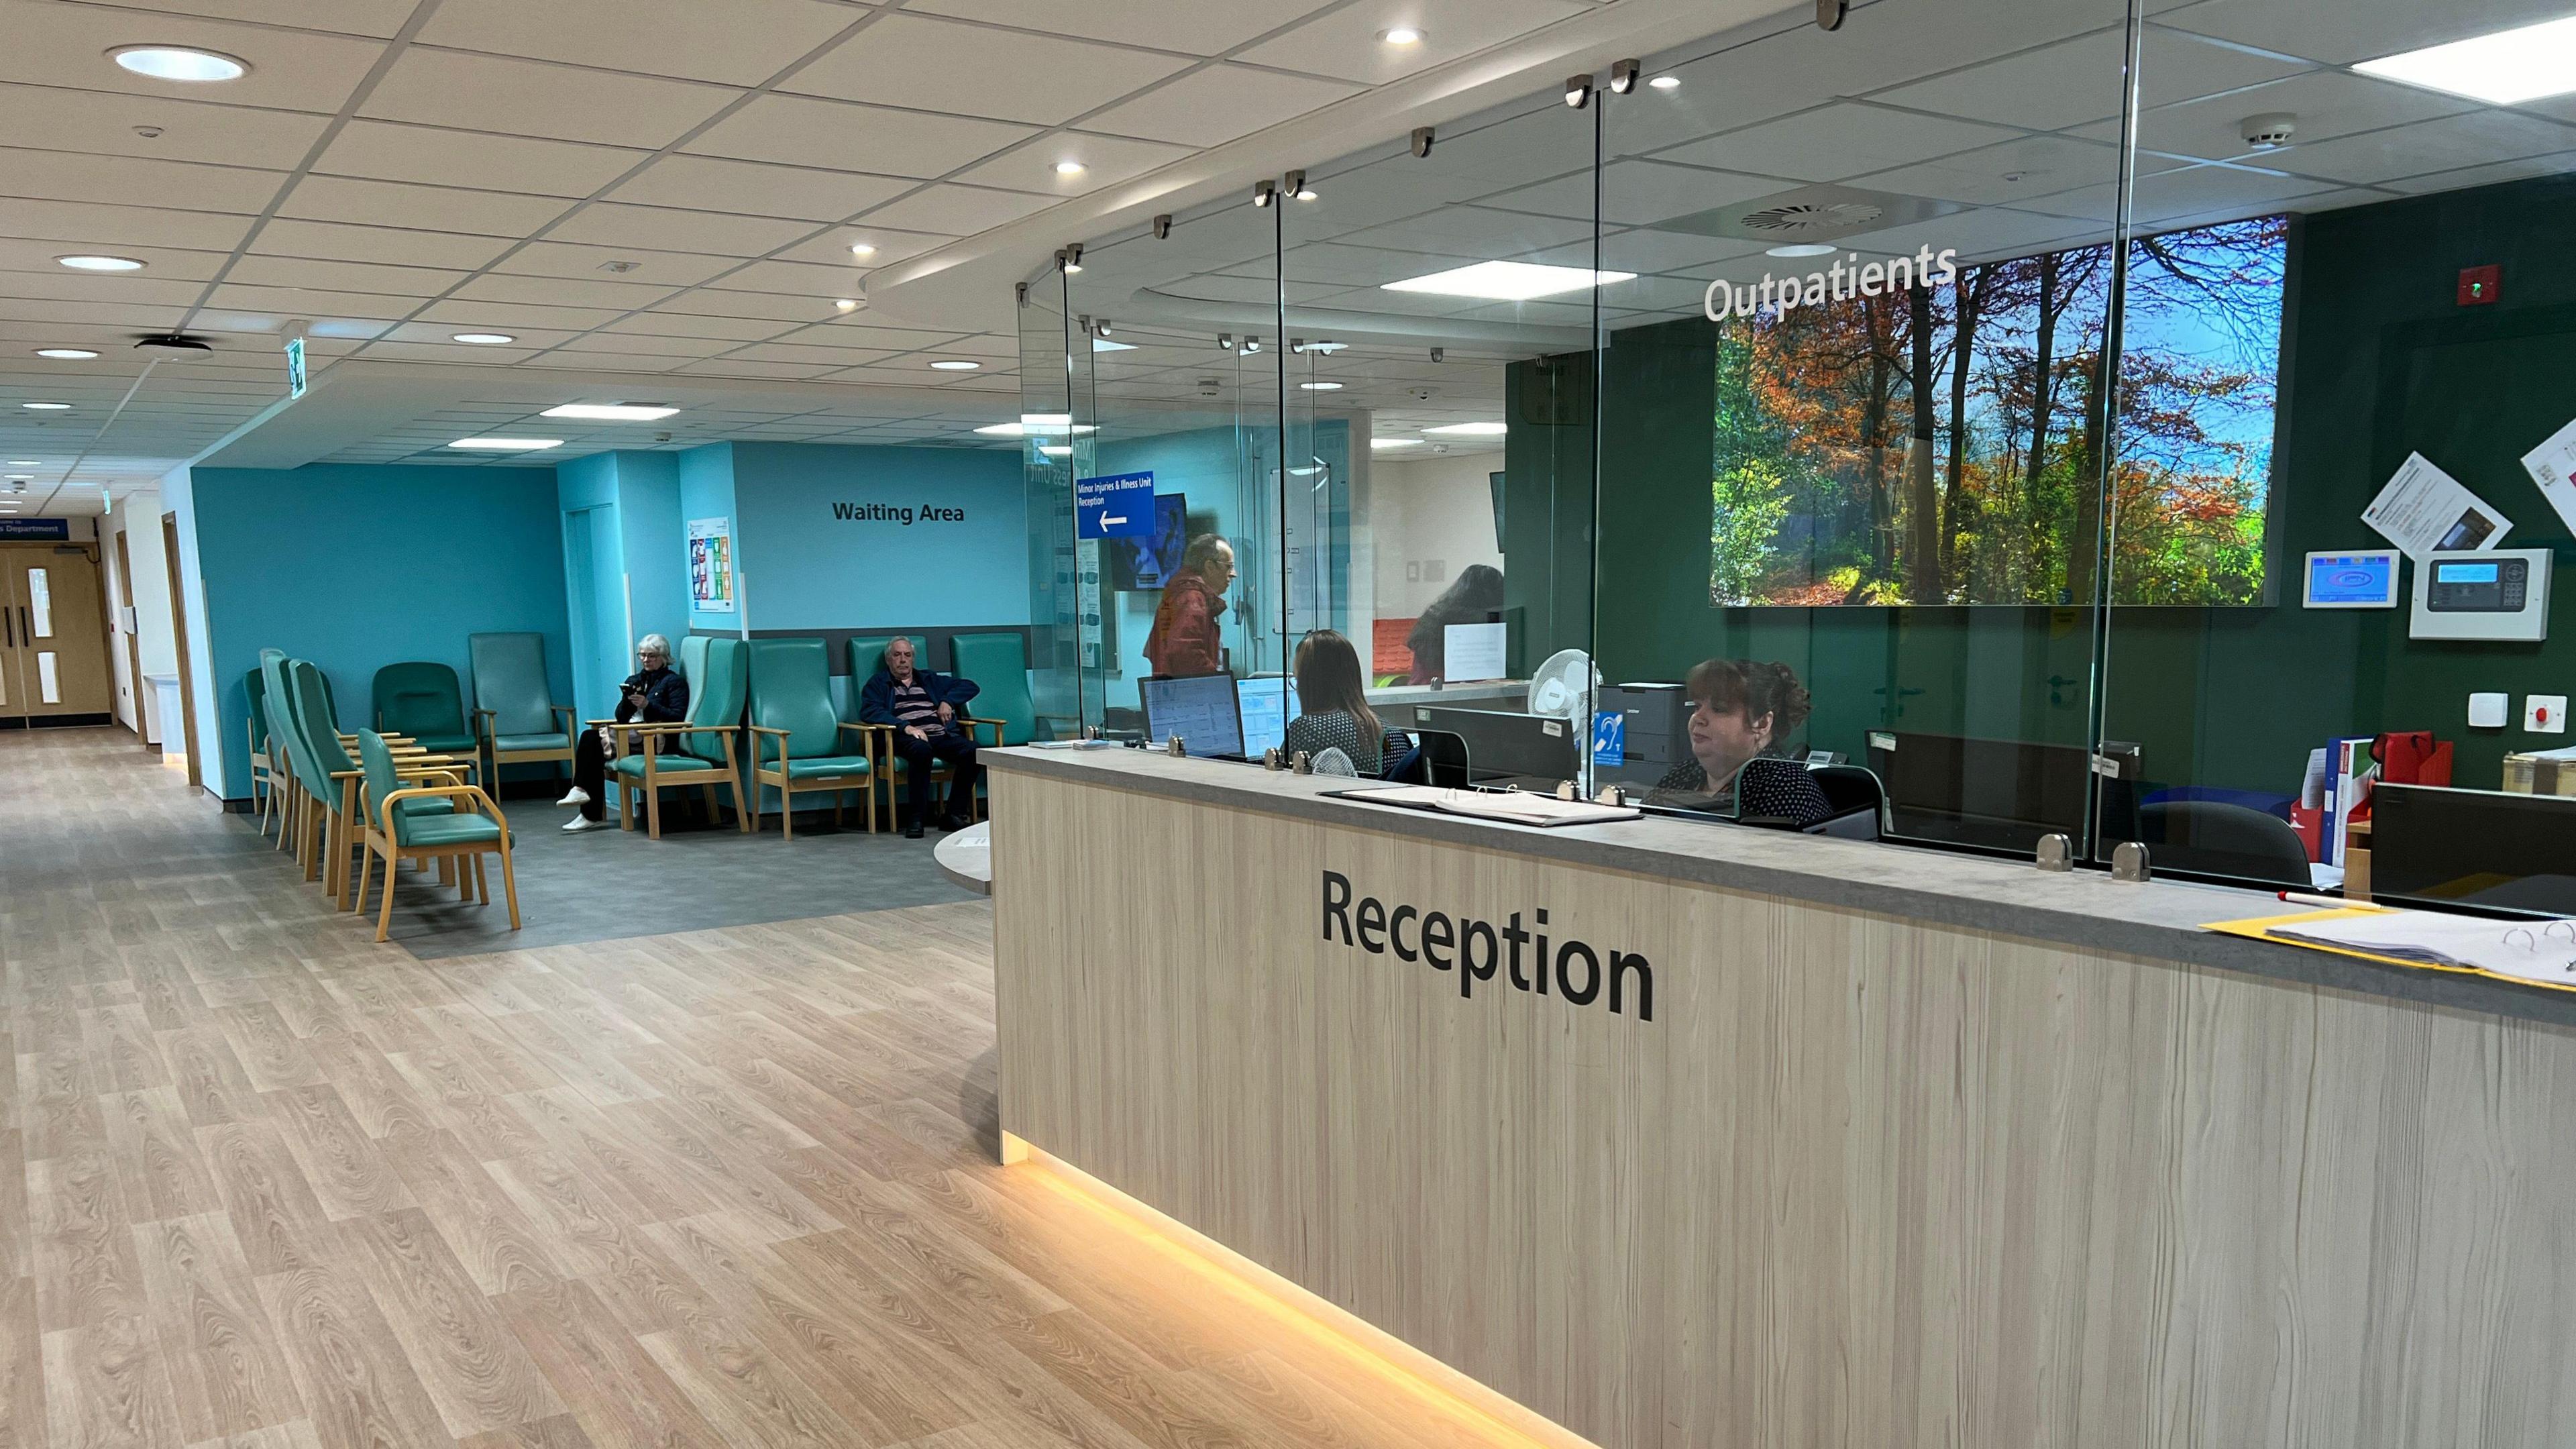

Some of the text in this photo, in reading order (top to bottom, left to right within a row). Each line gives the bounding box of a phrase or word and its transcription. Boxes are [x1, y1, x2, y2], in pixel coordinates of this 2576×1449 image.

[1705, 243, 1956, 323] Outpatients
[1078, 476, 1152, 494] Minor Injuries & Illness Unit
[1078, 496, 1104, 508] Reception
[833, 503, 964, 525] Waiting Area
[6, 525, 59, 533] Department
[1322, 869, 1652, 1022] Reception
